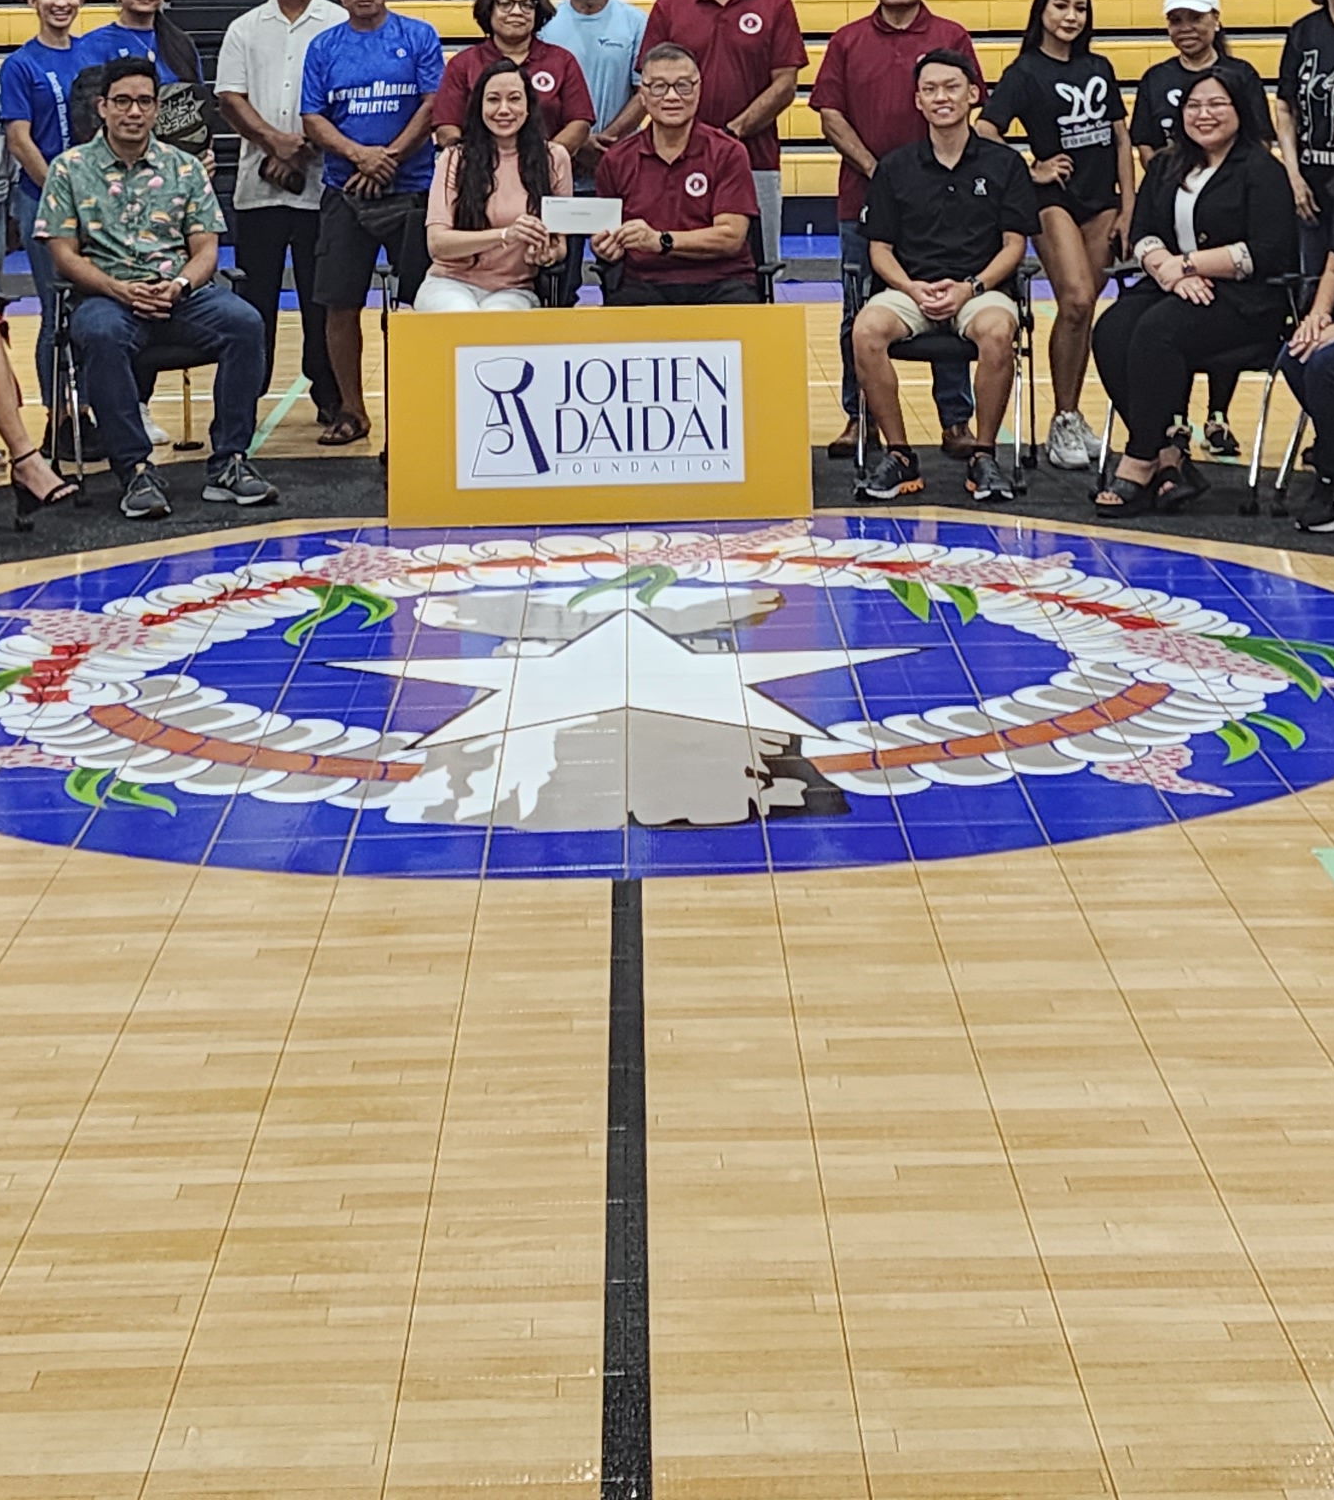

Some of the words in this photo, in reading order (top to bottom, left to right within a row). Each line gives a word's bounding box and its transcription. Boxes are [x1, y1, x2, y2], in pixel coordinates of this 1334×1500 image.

[555, 355, 728, 406] JOETEN
[555, 404, 729, 455] DAIDAI
[555, 458, 732, 475] FOUNDATION
